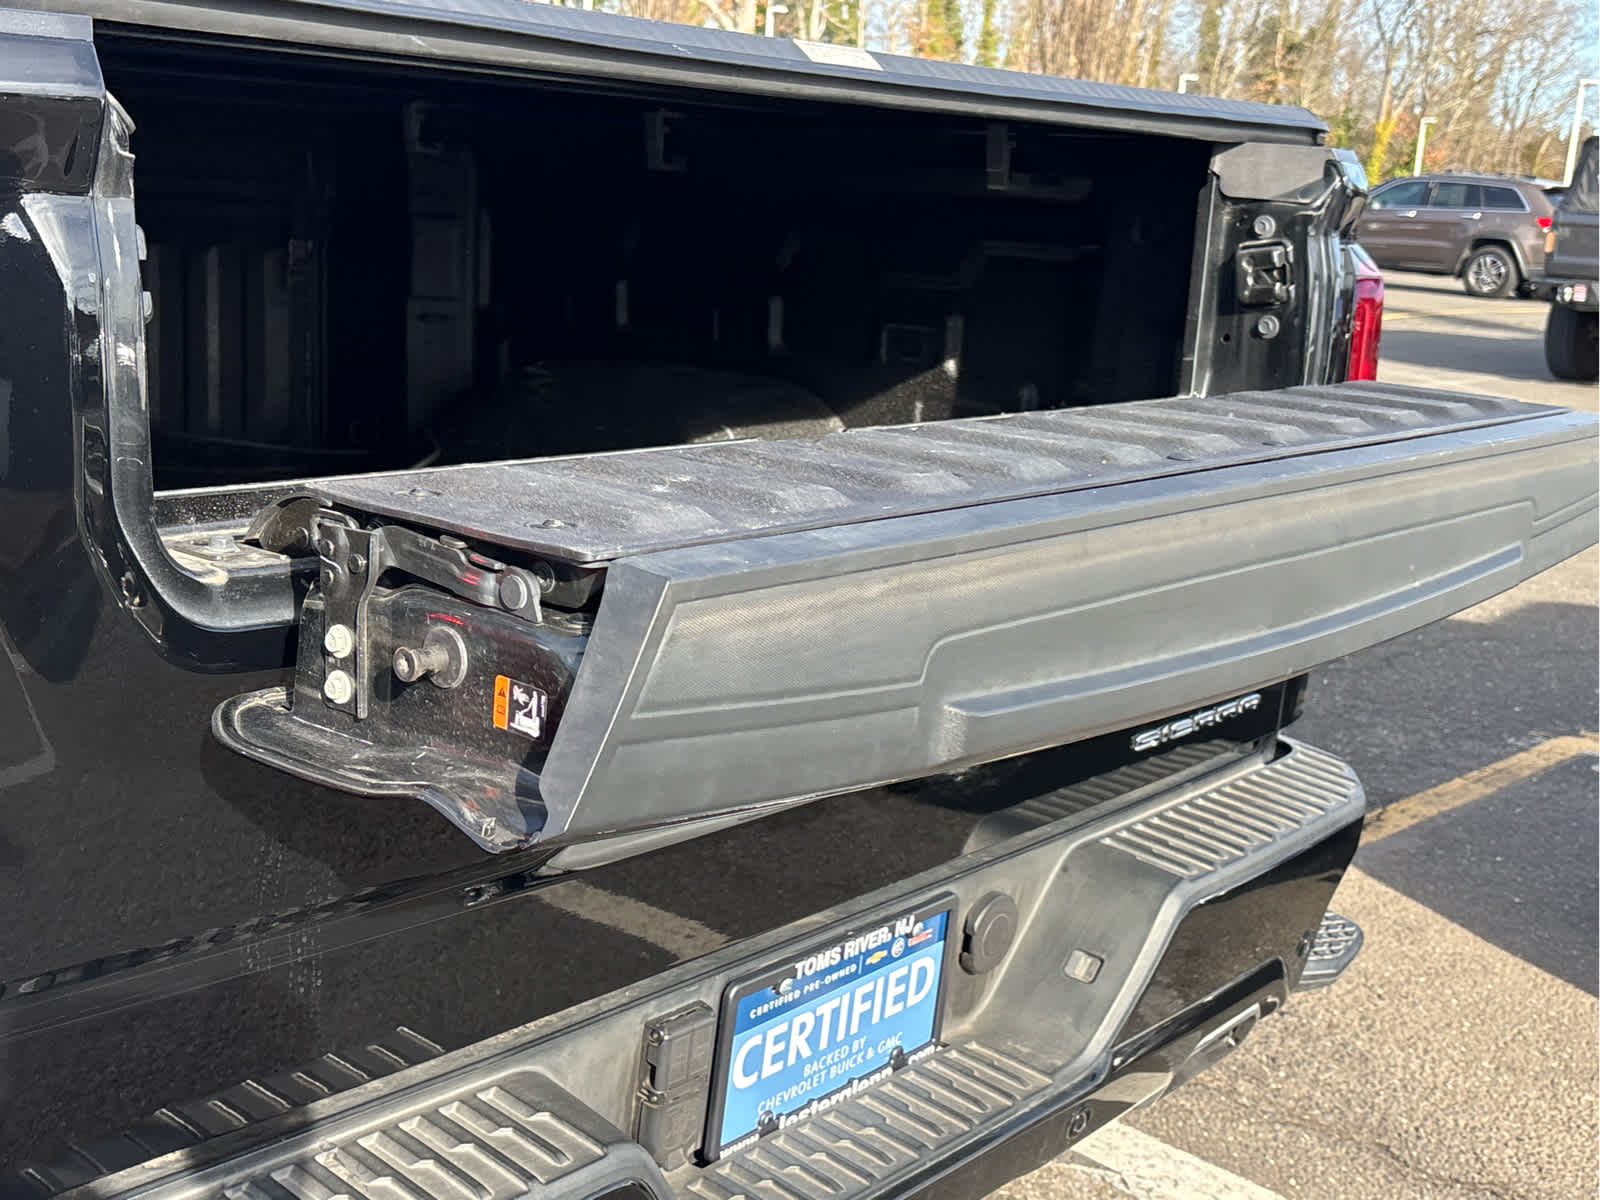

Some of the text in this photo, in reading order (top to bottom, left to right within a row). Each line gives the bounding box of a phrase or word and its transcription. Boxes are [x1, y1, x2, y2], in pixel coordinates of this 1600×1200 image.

[1130, 693, 1262, 752] SIERRA
[794, 947, 843, 979] TOMS
[844, 926, 893, 960] RIVER,
[894, 914, 915, 938] NJ
[749, 963, 857, 1019] CERTIFIED PRE-OWNED
[732, 956, 935, 1089] CERTIFIED
[757, 1032, 903, 1115] CHEVROLET BUICK & GMC
[803, 1036, 867, 1078] BACKED BY
